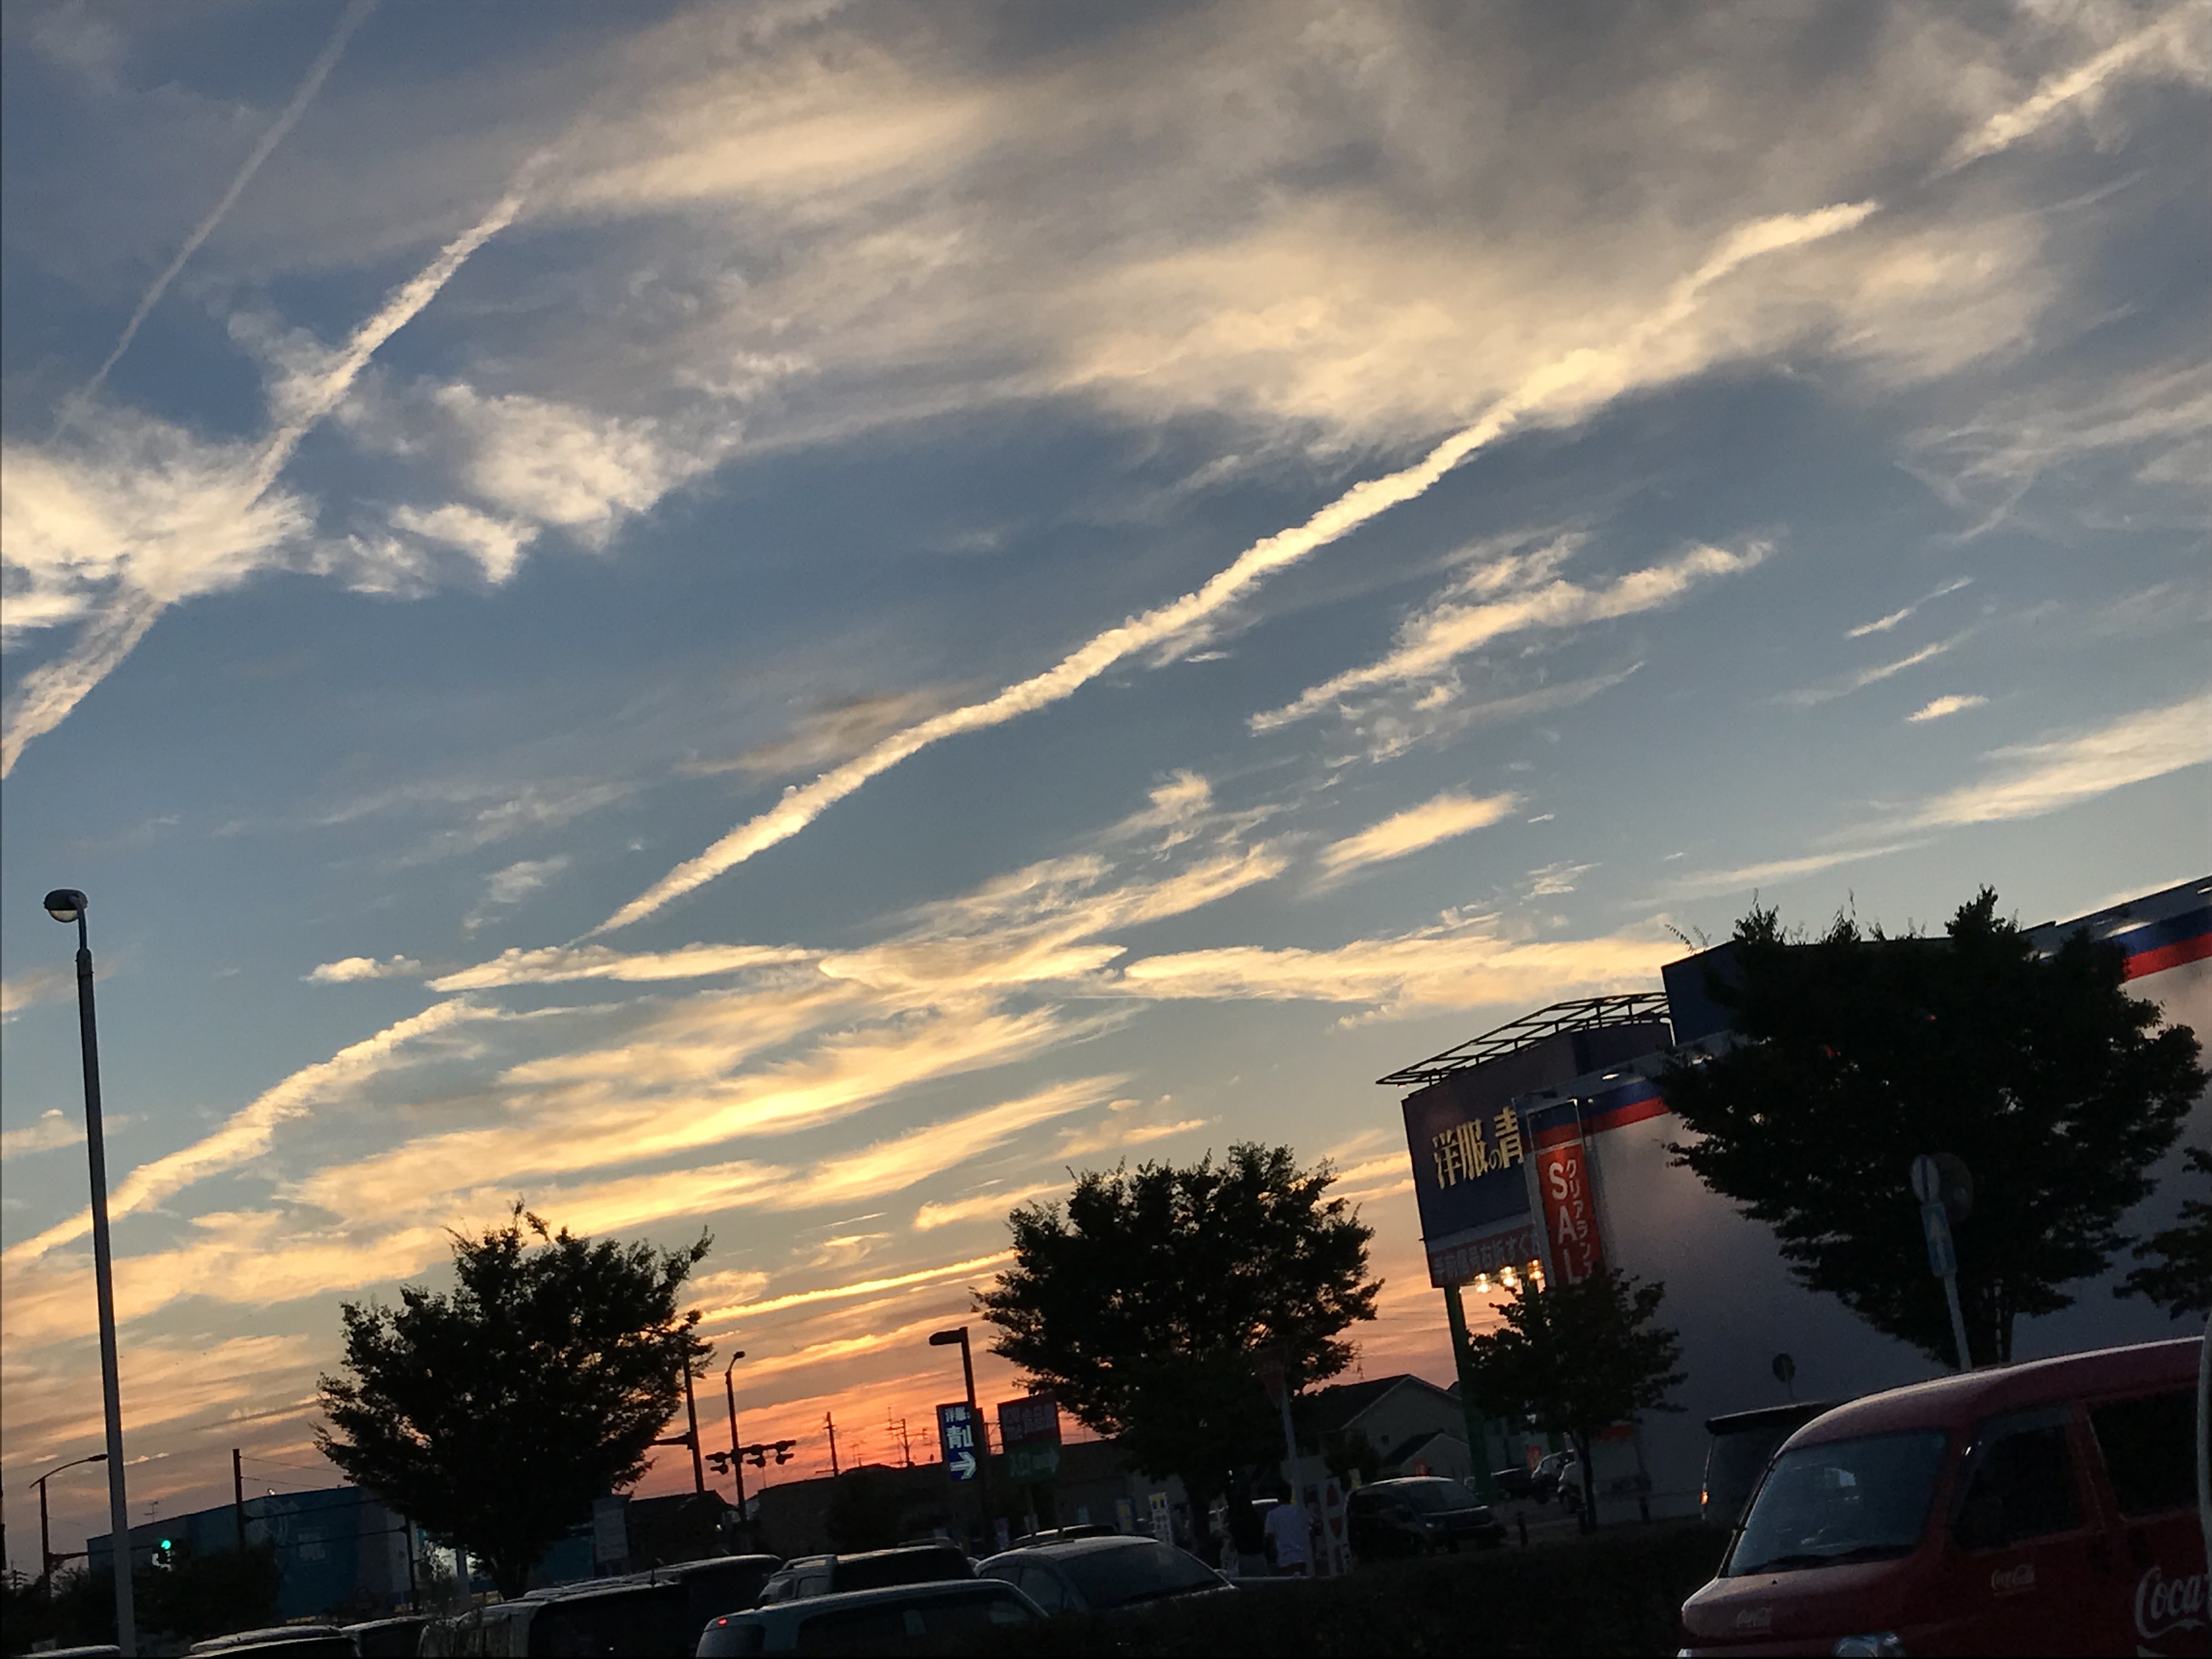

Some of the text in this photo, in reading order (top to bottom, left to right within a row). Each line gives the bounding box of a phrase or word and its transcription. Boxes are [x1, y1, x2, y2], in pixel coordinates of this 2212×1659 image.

[1432, 1105, 1524, 1190] 洋服の青
[946, 1424, 974, 1449] 青山
